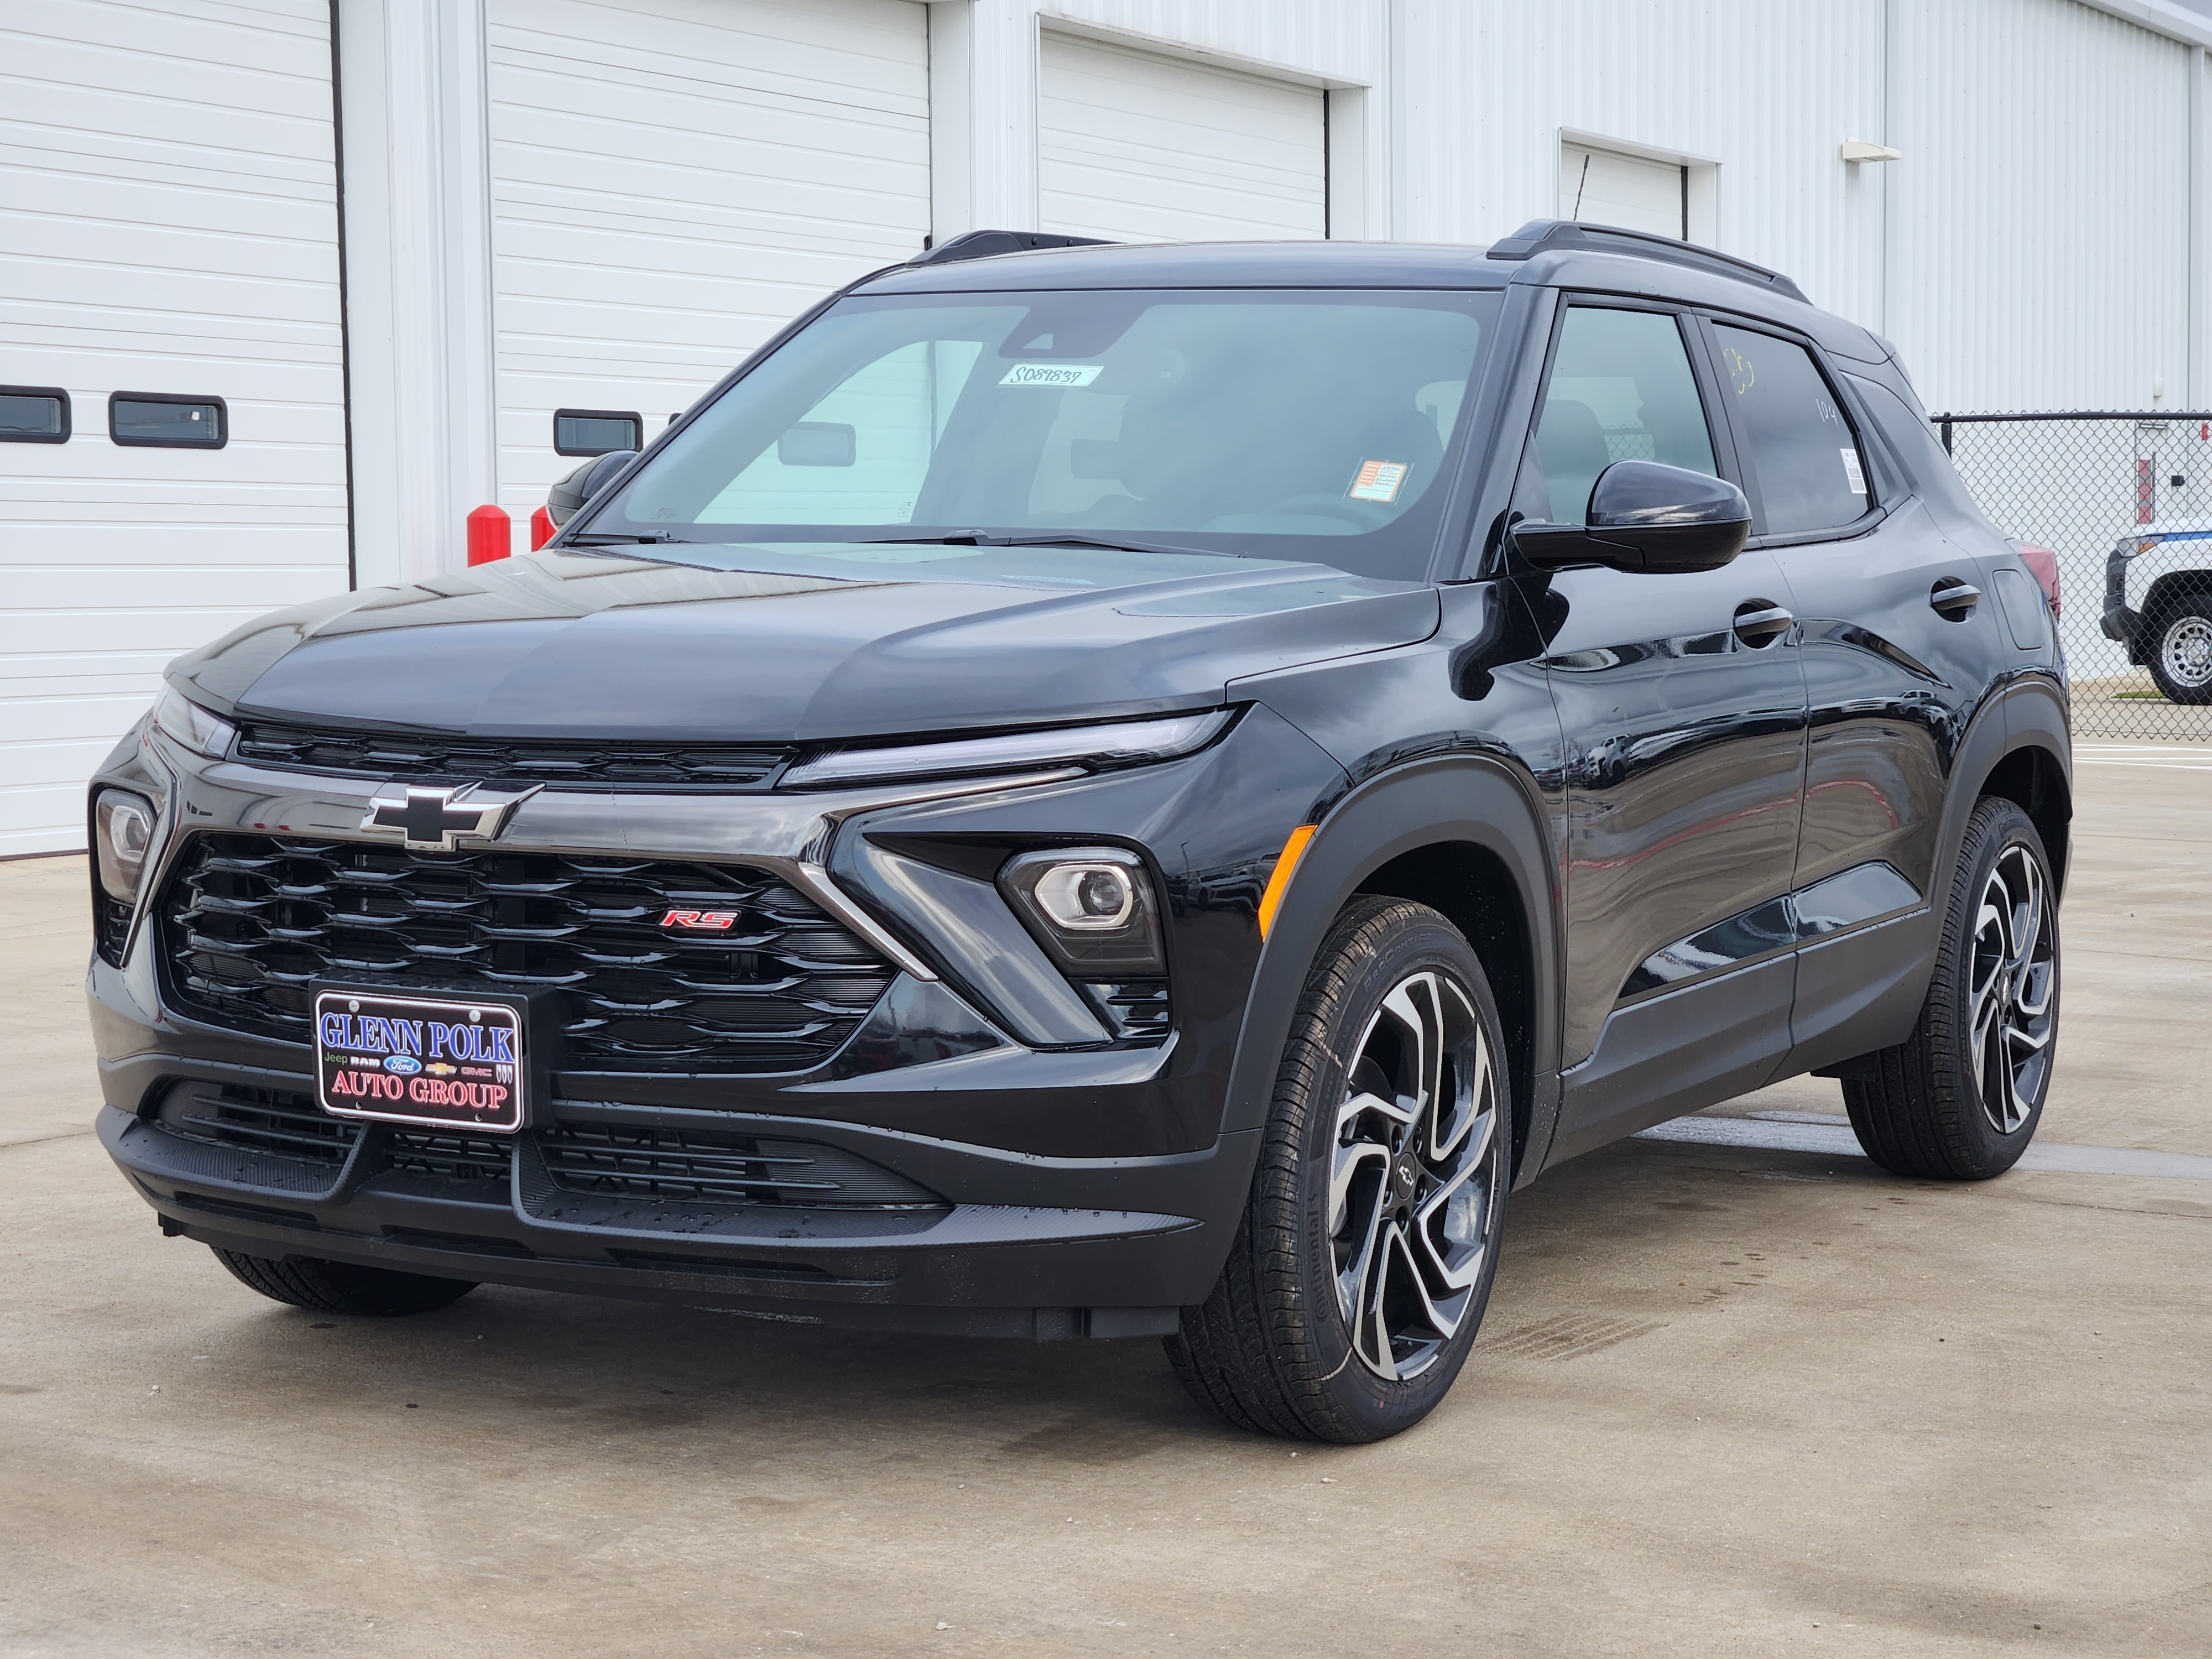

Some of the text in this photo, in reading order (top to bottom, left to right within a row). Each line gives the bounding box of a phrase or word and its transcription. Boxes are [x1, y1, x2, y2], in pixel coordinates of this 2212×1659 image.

[658, 910, 739, 929] RS
[320, 1012, 515, 1063] GLENN POLK
[324, 1051, 493, 1077] Jeep RAM Ford GMC
[332, 1070, 508, 1109] AUTO GROUP
